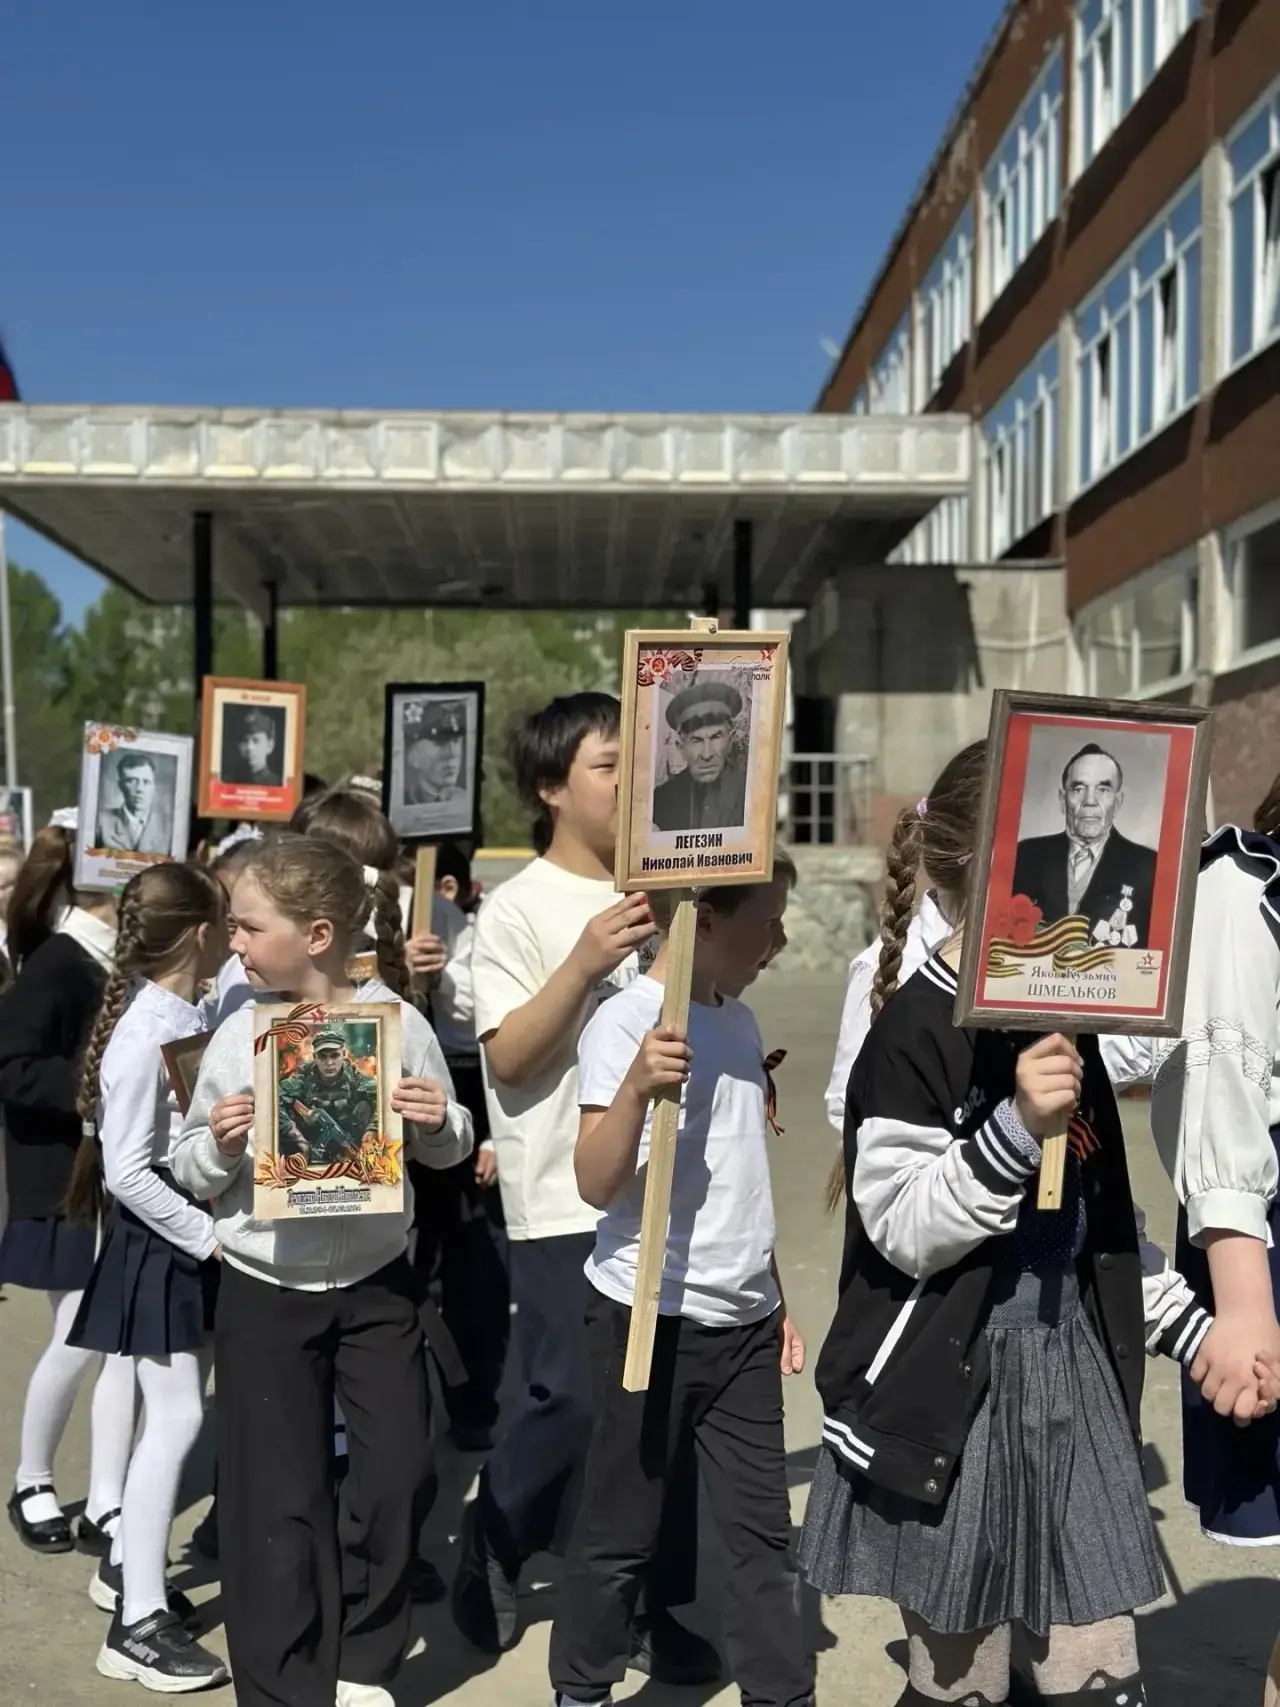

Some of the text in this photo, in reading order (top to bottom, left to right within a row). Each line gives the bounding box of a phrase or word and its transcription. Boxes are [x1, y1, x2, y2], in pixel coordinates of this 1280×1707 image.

[675, 833, 723, 849] ЛЕГЕЗИН
[642, 852, 753, 871] Николай Иванович
[1031, 966, 1117, 982] Яков Кузьмич
[1027, 984, 1117, 1000] ШМЕЛЬКОВ
